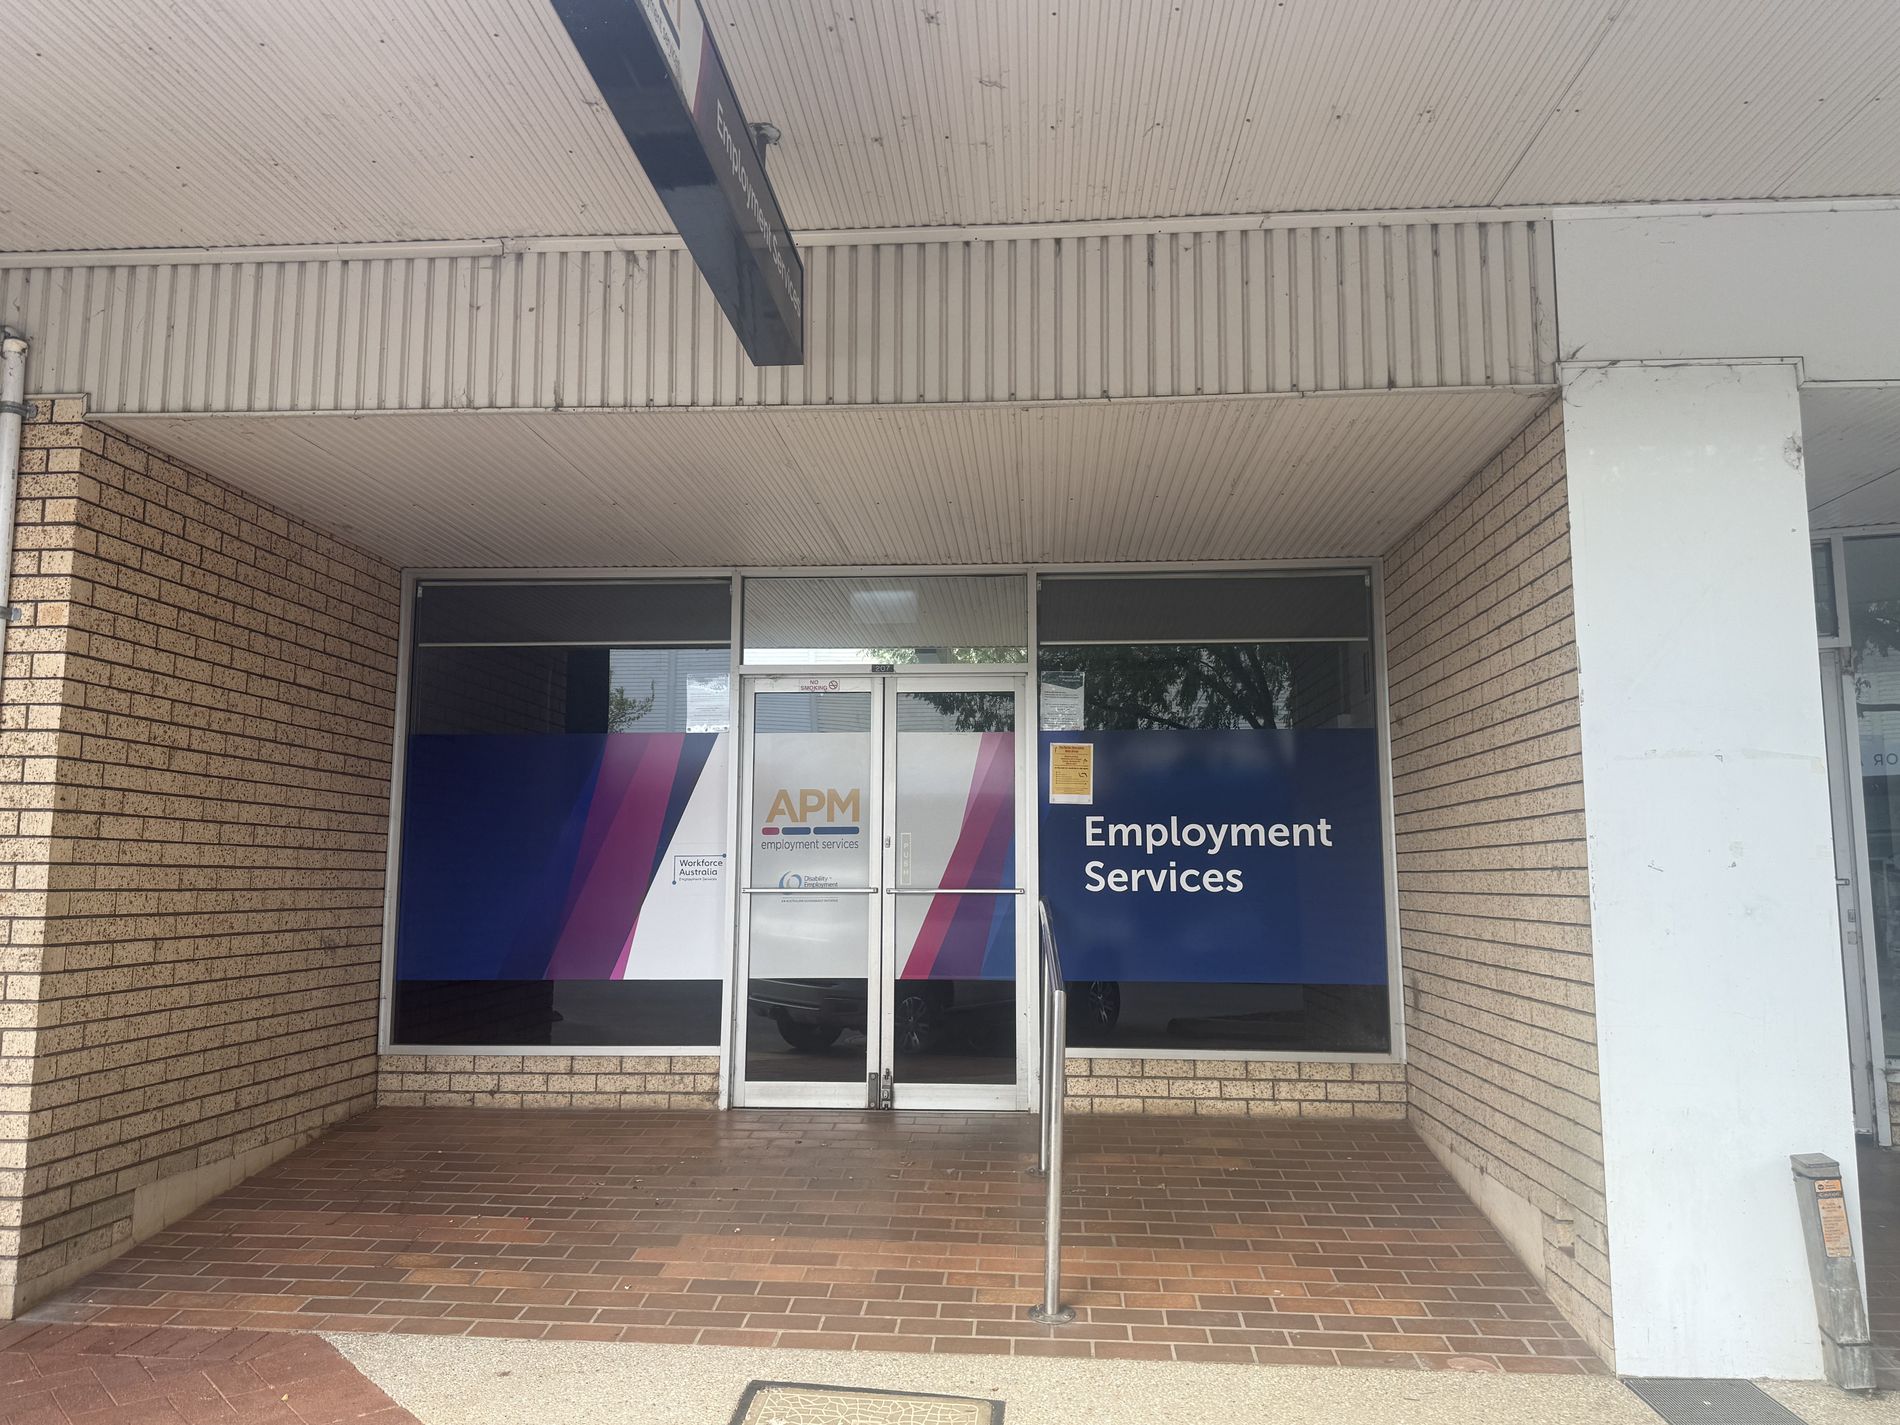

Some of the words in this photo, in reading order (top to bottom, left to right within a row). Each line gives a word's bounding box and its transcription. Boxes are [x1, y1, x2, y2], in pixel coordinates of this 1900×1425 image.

[716, 98, 773, 249] Employment
[772, 232, 802, 318] Services
[765, 788, 860, 823] APM
[761, 839, 820, 852] employment
[821, 838, 859, 850] services
[1085, 815, 1332, 855] Employment
[679, 858, 724, 867] Workforce
[679, 868, 718, 876] Australia
[804, 881, 839, 889] Employment
[1085, 860, 1243, 893] Services
